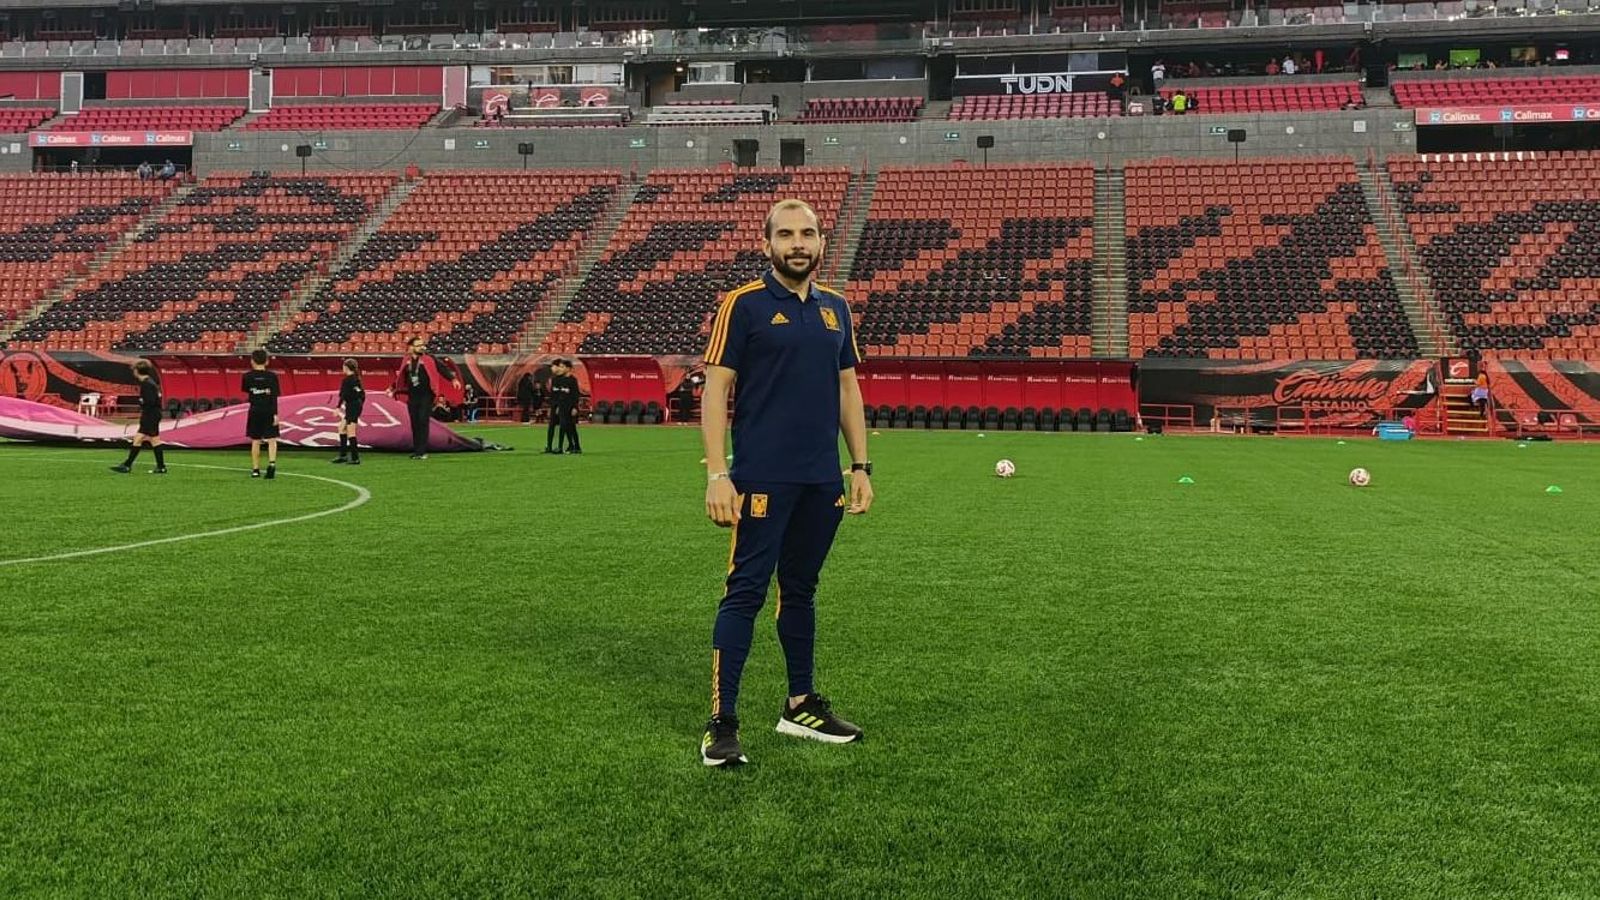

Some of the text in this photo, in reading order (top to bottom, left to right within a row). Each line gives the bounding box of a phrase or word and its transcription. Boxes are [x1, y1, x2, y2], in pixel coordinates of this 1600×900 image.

[1000, 75, 1073, 94] TUDN
[1442, 112, 1481, 122] Calimax
[1514, 110, 1553, 120] Calimax
[47, 135, 77, 144] Calimax
[101, 134, 131, 143] Calimax
[155, 133, 185, 143] Calimax
[1273, 368, 1389, 403] Caliente
[1301, 401, 1369, 412] ESTADIO
